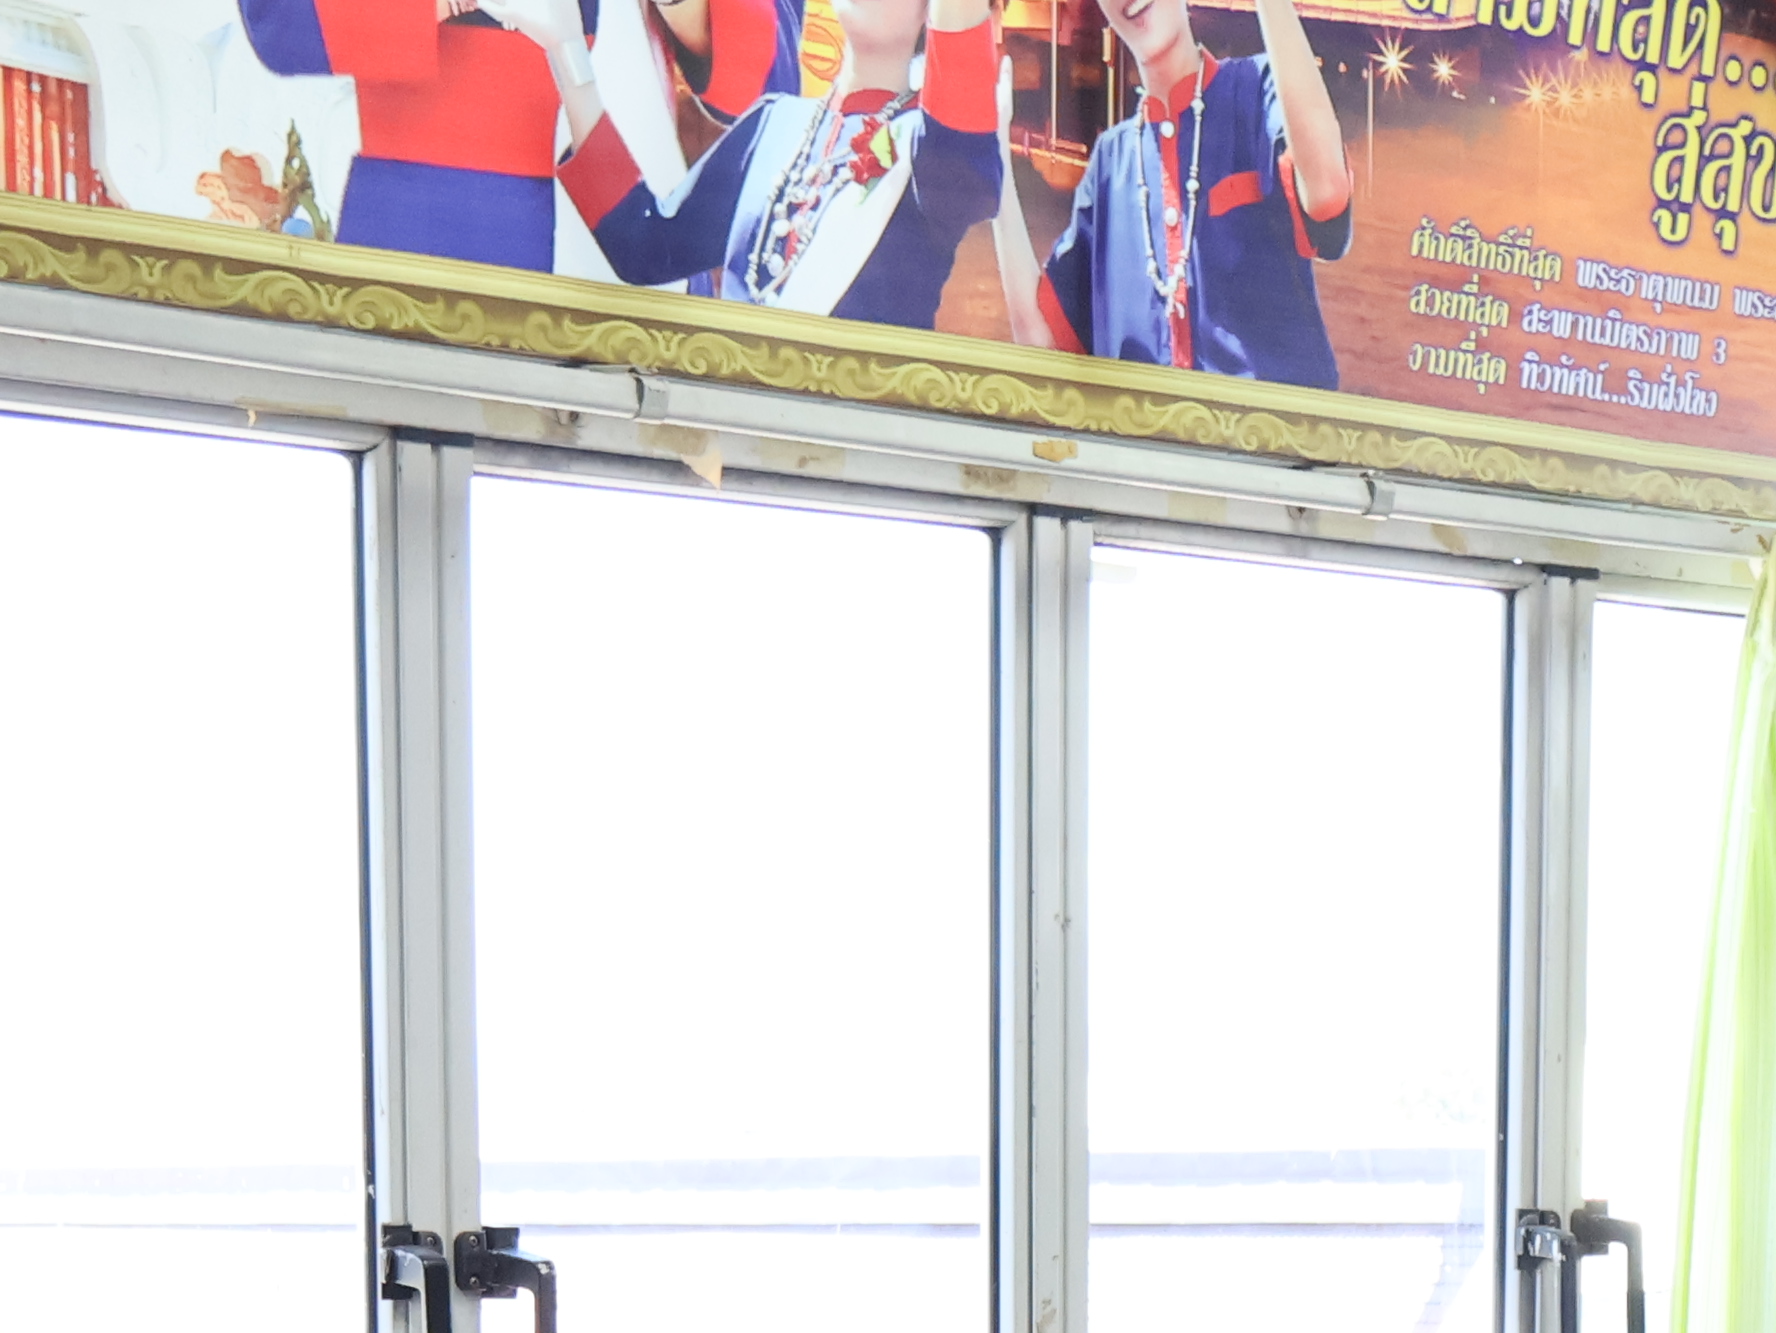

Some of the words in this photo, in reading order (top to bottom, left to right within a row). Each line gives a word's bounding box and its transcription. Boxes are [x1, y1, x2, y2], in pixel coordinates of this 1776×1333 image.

[1411, 217, 1562, 290] ศักดิ์สิทธิ์ที่สุด
[1576, 258, 1720, 314] พระธาตุพนม
[1408, 331, 1507, 395] งามที่สุด
[1409, 274, 1510, 337] สวยที่สุด
[1521, 303, 1700, 361] สะพานมิตรภาพ
[1712, 338, 1728, 364] 3
